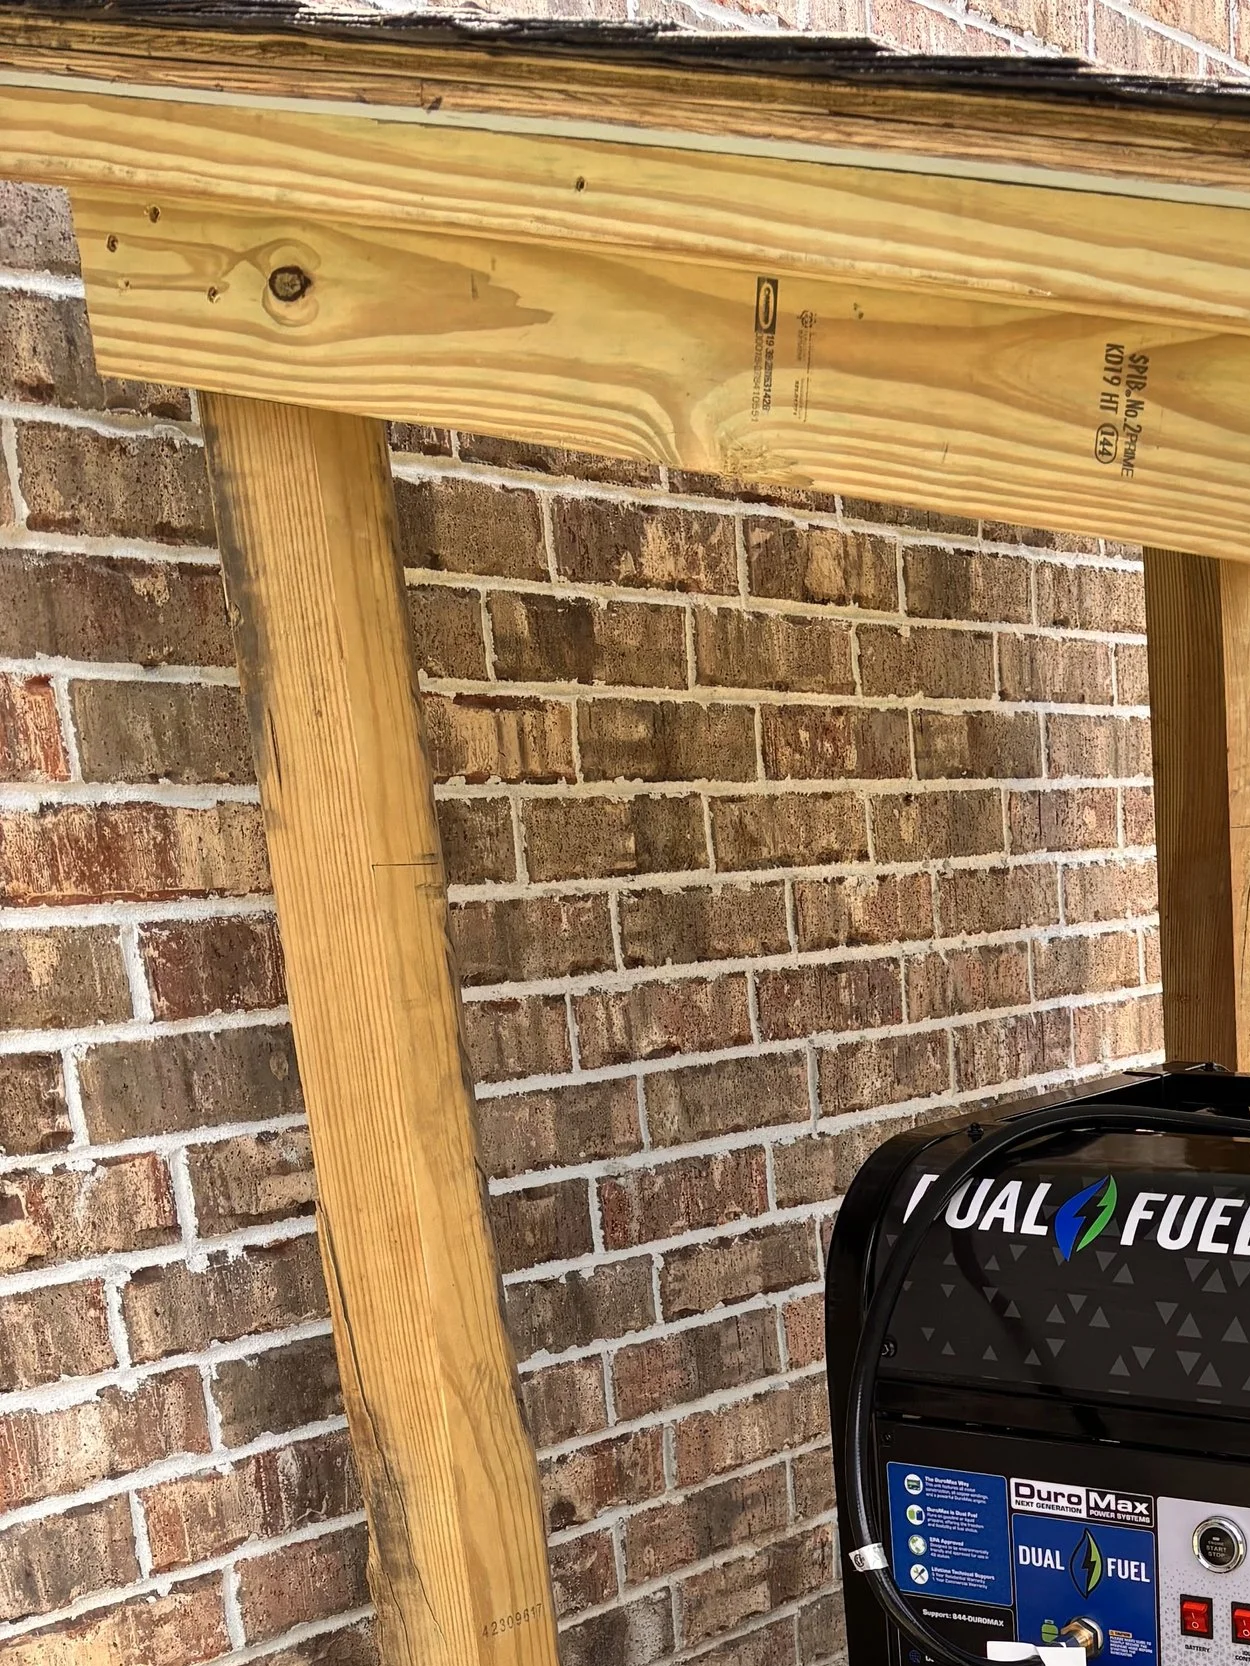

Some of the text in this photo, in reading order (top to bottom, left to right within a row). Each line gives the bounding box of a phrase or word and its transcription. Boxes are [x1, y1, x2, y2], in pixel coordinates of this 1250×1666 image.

[1100, 343, 1124, 415] KD19 HT
[1098, 429, 1115, 457] 144
[1015, 1499, 1082, 1514] NEXT GENERATION
[1090, 1509, 1151, 1524] POWER SYSTEMS
[1206, 1545, 1227, 1553] START
[1018, 1545, 1065, 1571] DUAL
[1107, 1557, 1151, 1583] FUEL
[922, 1608, 952, 1619] Support:
[1184, 1644, 1211, 1654] BATTERY
